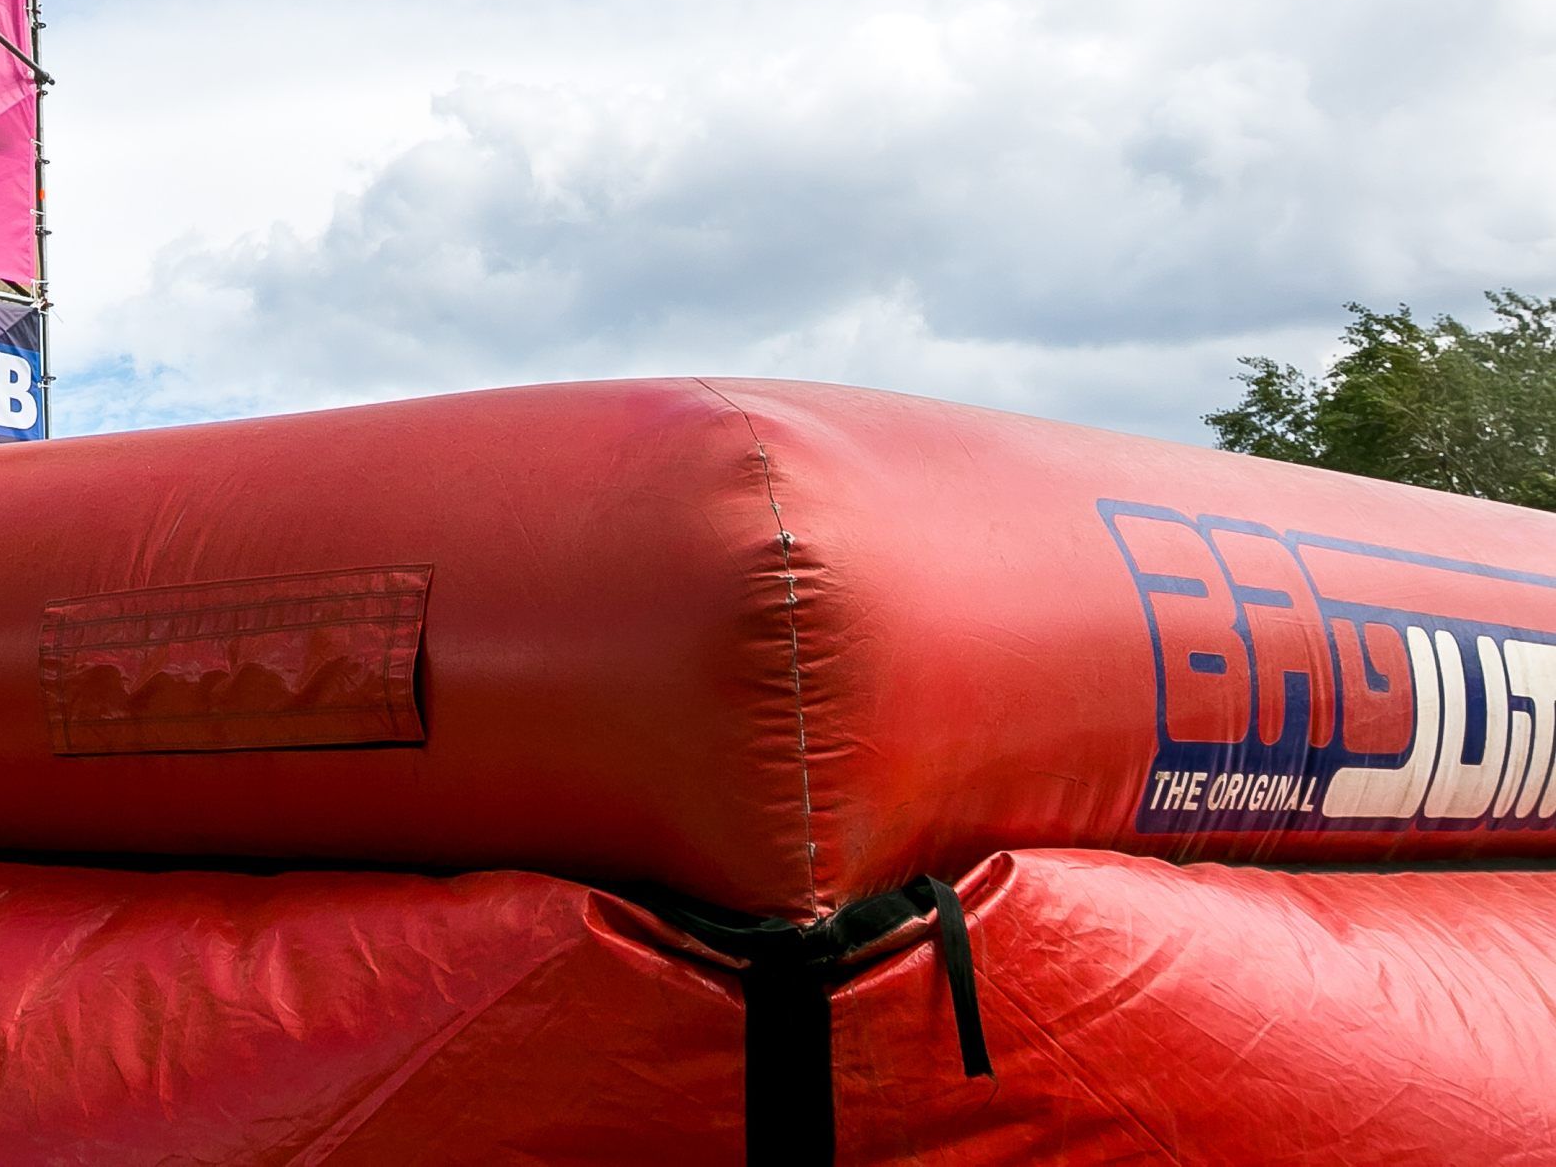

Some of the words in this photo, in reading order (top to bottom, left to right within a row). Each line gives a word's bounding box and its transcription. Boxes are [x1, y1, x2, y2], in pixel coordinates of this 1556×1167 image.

[1097, 498, 1504, 755] BAG
[1149, 770, 1209, 812] THE
[1207, 773, 1318, 813] ORIGINAL
